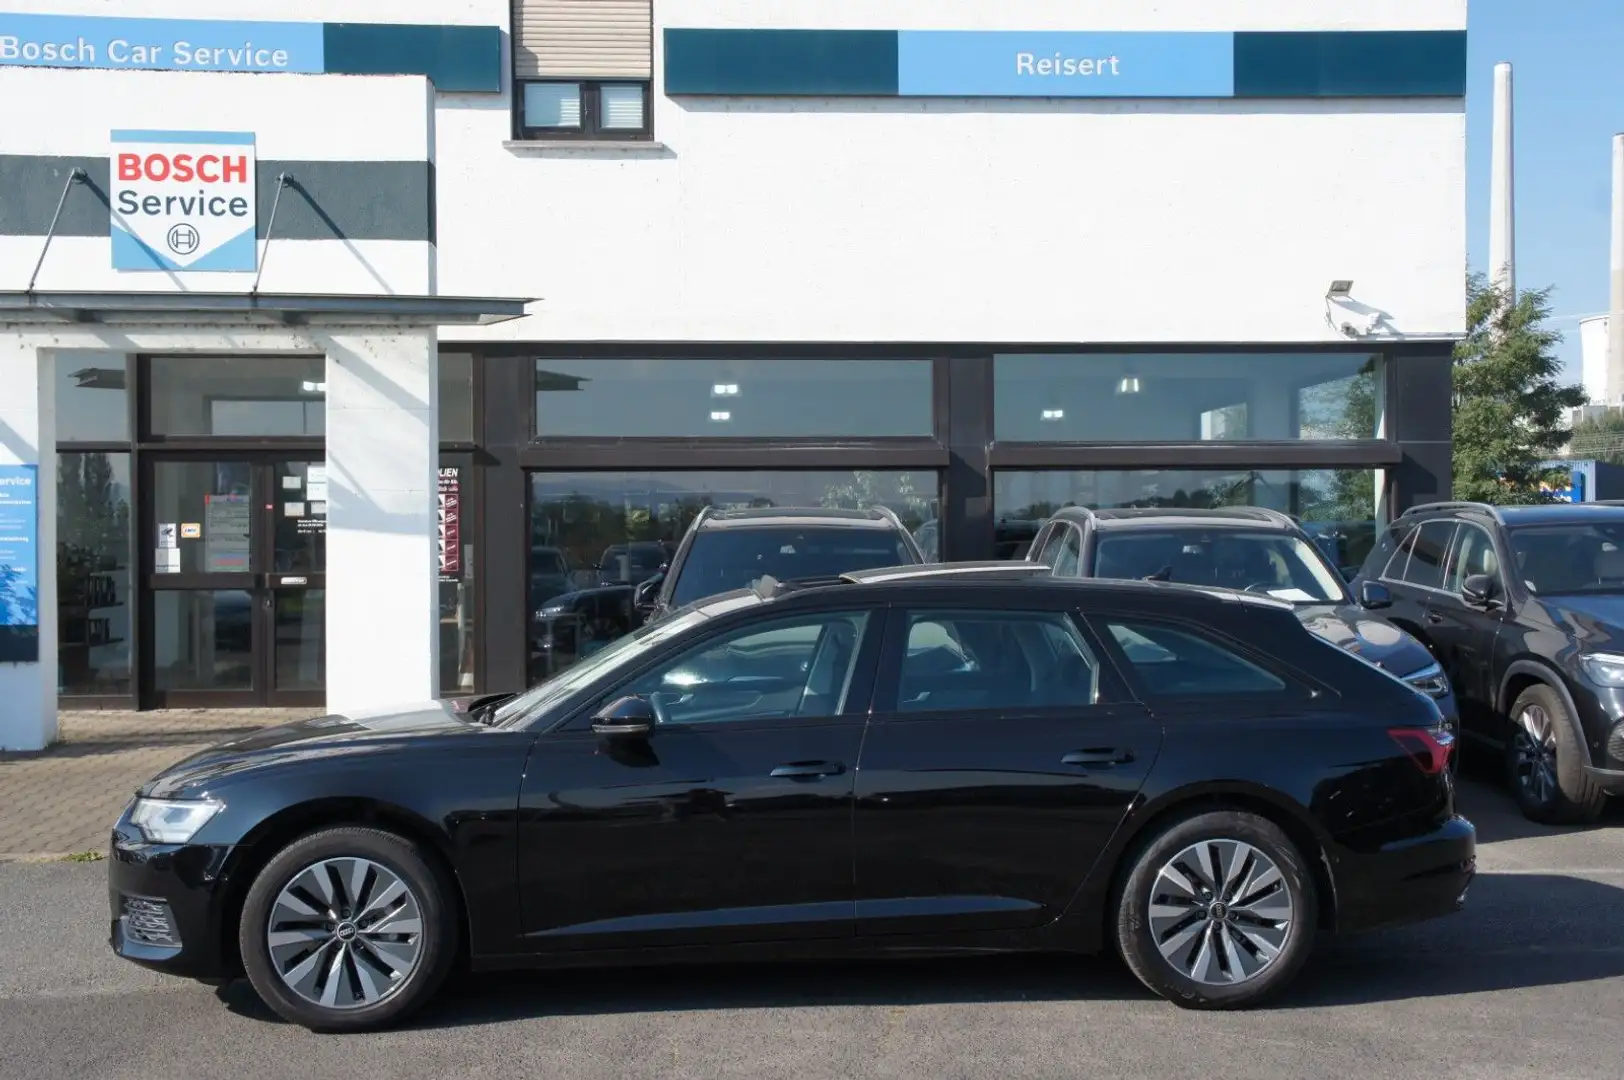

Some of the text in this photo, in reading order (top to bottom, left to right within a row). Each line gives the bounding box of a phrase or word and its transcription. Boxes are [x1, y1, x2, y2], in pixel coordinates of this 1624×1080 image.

[0, 35, 289, 68] Bosch Car Service
[1016, 51, 1120, 77] Reisert
[117, 153, 248, 183] BOSCH
[117, 190, 248, 217] Service
